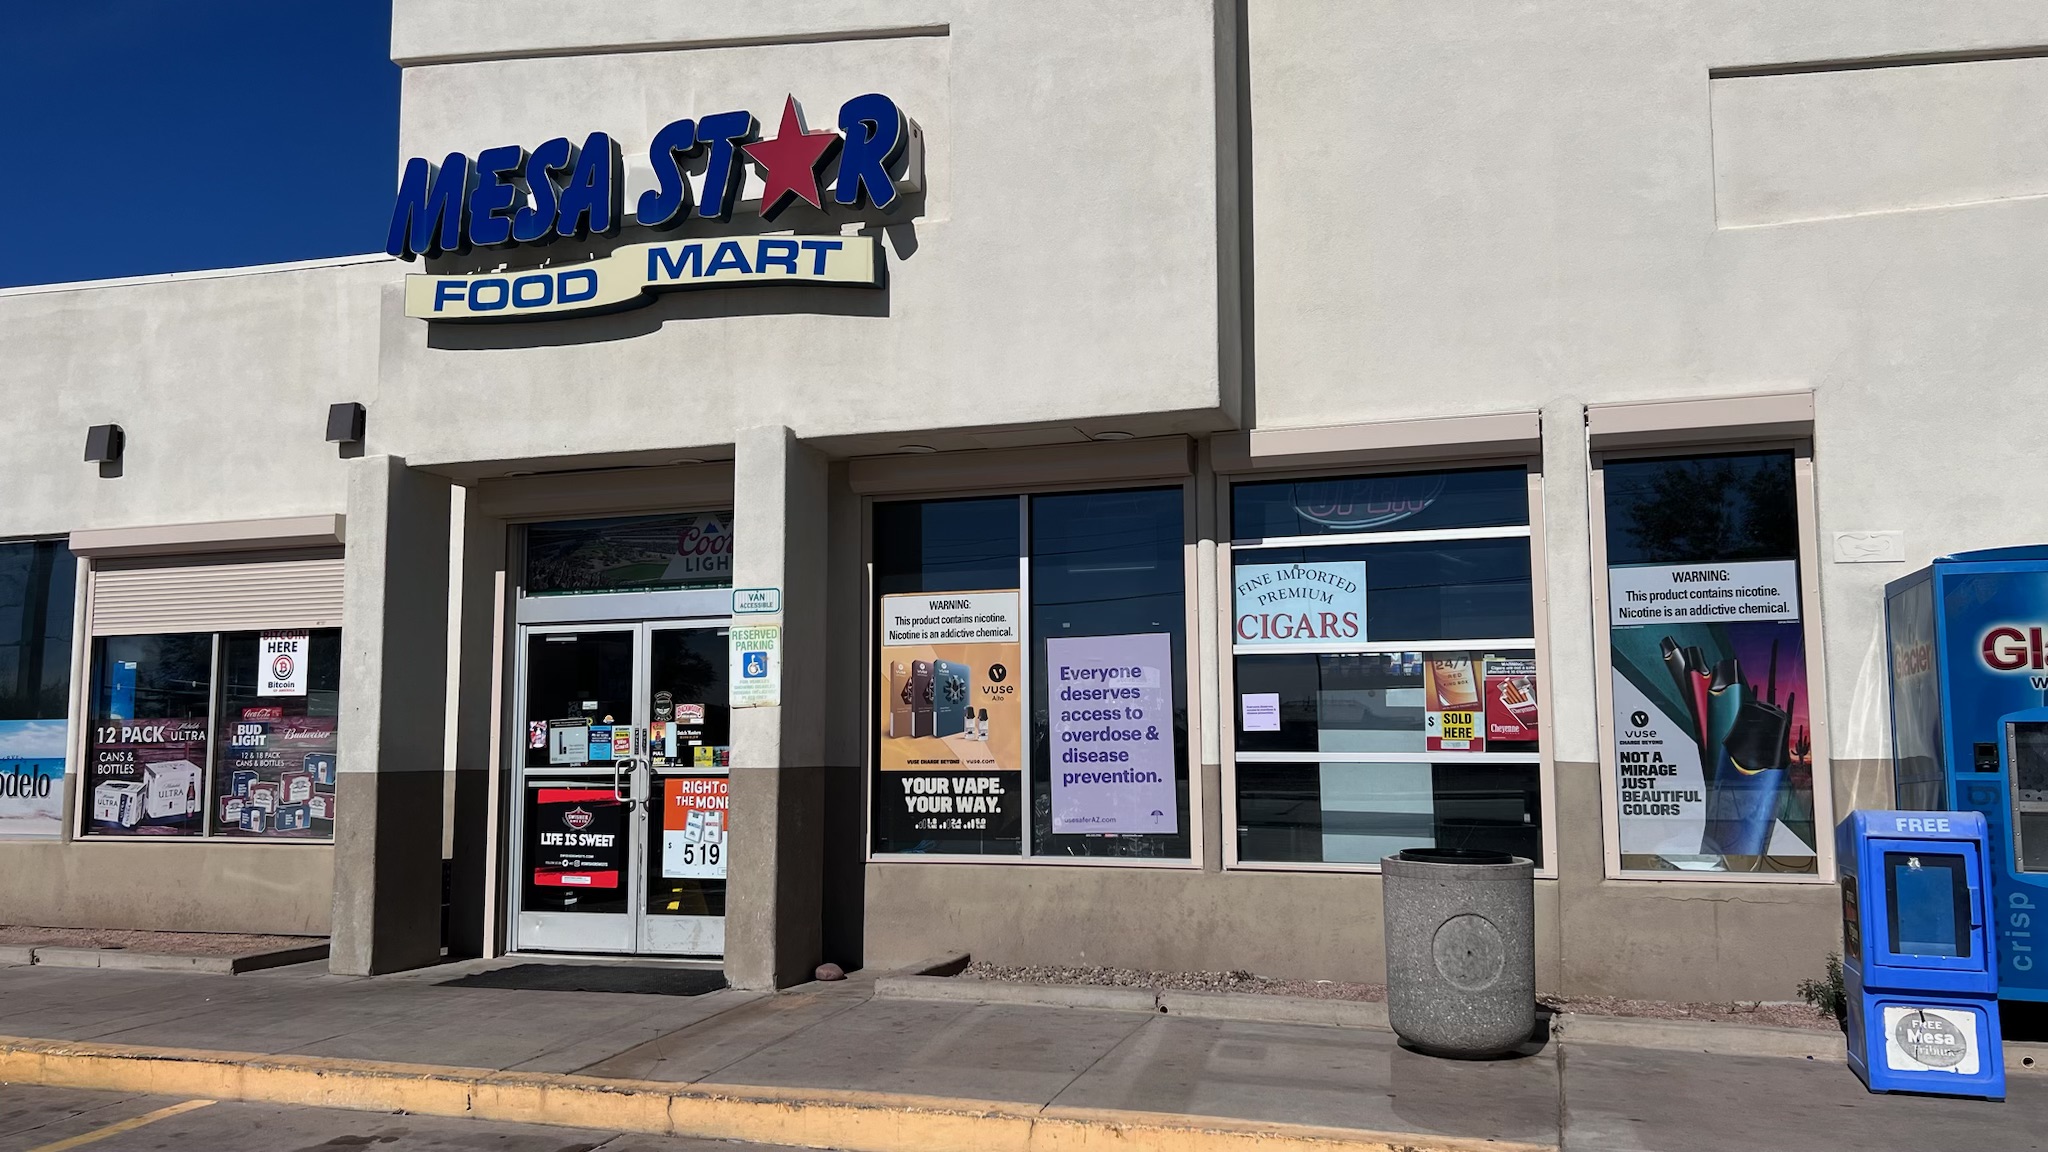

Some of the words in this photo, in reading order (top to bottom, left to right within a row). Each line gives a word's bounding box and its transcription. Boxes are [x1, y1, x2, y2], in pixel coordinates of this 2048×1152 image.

[386, 131, 616, 259] MESA
[434, 269, 598, 312] FOOD
[647, 240, 843, 281] MART
[1237, 573, 1272, 597] FINE
[1276, 568, 1357, 594] IMPORTED
[1672, 570, 1730, 583] WARNING:
[1257, 587, 1334, 606] PREMIUM
[1626, 590, 1648, 602] This
[1650, 588, 1688, 603] product
[1690, 586, 1733, 599] contains
[1736, 585, 1780, 598] nicotine.
[929, 599, 971, 610] WARNING:
[1619, 606, 1662, 618] Nicotine
[1663, 606, 1673, 617] is
[1675, 607, 1687, 616] an
[1689, 603, 1736, 616] addictive
[1738, 602, 1790, 614] chemical.
[895, 616, 911, 626] This
[912, 615, 940, 627] product
[941, 613, 973, 625] contains
[974, 612, 1007, 623] nicotine.
[1237, 612, 1359, 640] CIGARS
[263, 630, 307, 640] BITCOIN
[732, 629, 777, 640] RESERVED
[889, 629, 920, 640] Nicotine
[922, 629, 928, 639] is
[930, 630, 939, 639] an
[940, 627, 975, 638] addictive
[976, 626, 1013, 637] chemical.
[267, 641, 298, 653] HERE
[736, 640, 774, 651] PARKING
[1435, 656, 1468, 670] 24/7
[1895, 640, 1931, 679] Glacier
[1060, 666, 1142, 682] Everyone
[982, 685, 1014, 694] vuse
[1060, 686, 1141, 701] deserves
[1061, 709, 1121, 722] access
[1125, 706, 1143, 720] to
[1443, 713, 1472, 724] SOLD
[1428, 716, 1435, 727] $
[97, 727, 116, 743] 12
[121, 726, 165, 743] PACK
[237, 724, 262, 735] BUD
[283, 728, 330, 740] Budweiser
[1061, 726, 1142, 743] overdose
[1145, 725, 1160, 741] &
[1444, 727, 1472, 738] HERE
[1490, 724, 1520, 733] Cheyenne
[1625, 730, 1657, 738] vuse
[170, 731, 206, 741] ULTRA
[232, 735, 266, 746] LIGHT
[100, 752, 125, 762] CANS
[127, 752, 134, 762] &
[1062, 748, 1129, 763] disease
[1620, 751, 1649, 763] NOT
[1652, 751, 1663, 763] A
[97, 764, 134, 775] BOTTLES
[1621, 764, 1677, 776] MIRAGE
[1063, 767, 1162, 787] prevention.
[1622, 778, 1656, 789] JUST
[682, 780, 720, 794] RIGHT
[721, 783, 729, 794] O
[902, 777, 949, 794] YOUR
[952, 777, 1005, 794] VAPE.
[159, 790, 184, 799] ULTRA
[676, 796, 694, 806] THE
[1622, 790, 1702, 802] BEAUTIFUL
[97, 799, 118, 807] ULTRA
[905, 796, 952, 813] YOUR
[955, 796, 1001, 813] WAY.
[1623, 803, 1680, 816] COLORS
[1895, 818, 1950, 832] FREE
[541, 833, 563, 845] LIFE
[564, 834, 578, 846] IS
[579, 834, 615, 847] SWEET
[2005, 892, 2036, 971] crisp
[1912, 1020, 1942, 1029] FREE
[1907, 1029, 1955, 1045] Mesa
